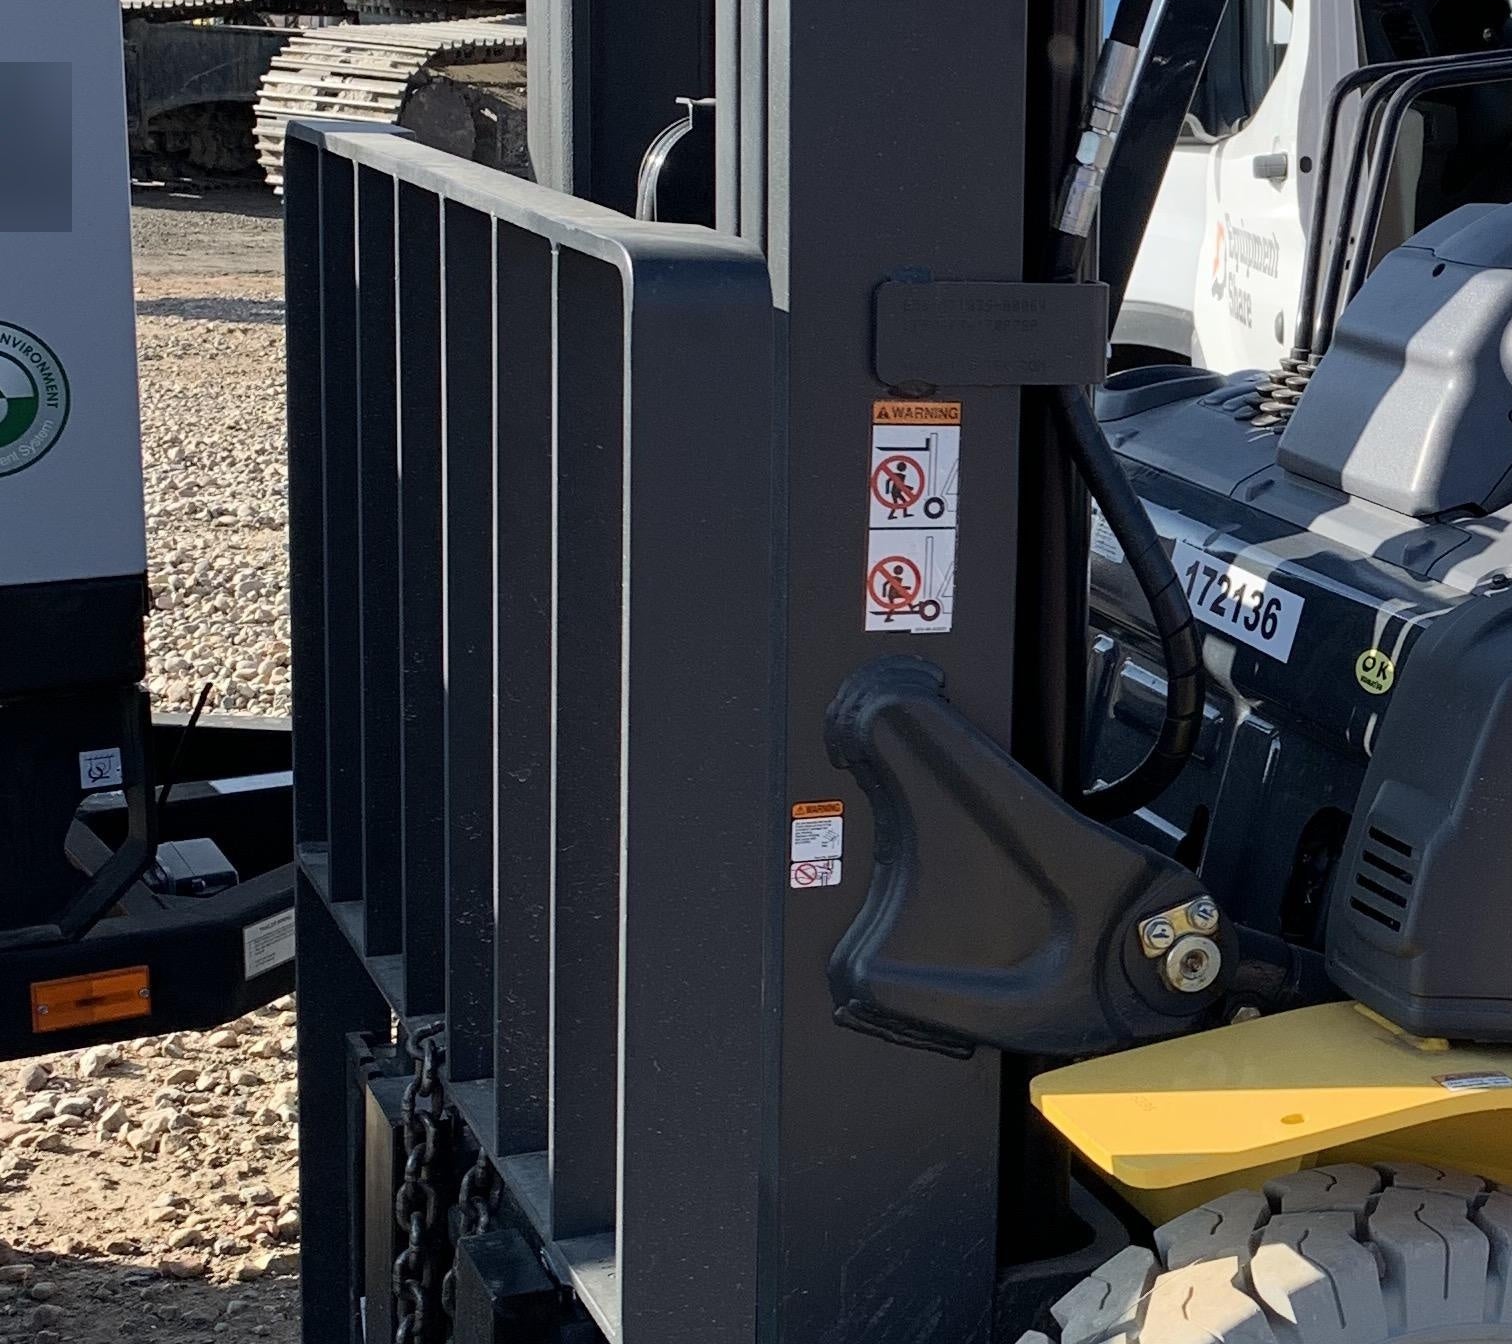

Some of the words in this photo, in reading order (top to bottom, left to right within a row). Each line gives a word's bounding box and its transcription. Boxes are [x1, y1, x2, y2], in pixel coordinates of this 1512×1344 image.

[891, 406, 960, 420] WARNING
[18, 419, 54, 457] System
[1185, 560, 1282, 641] 172136
